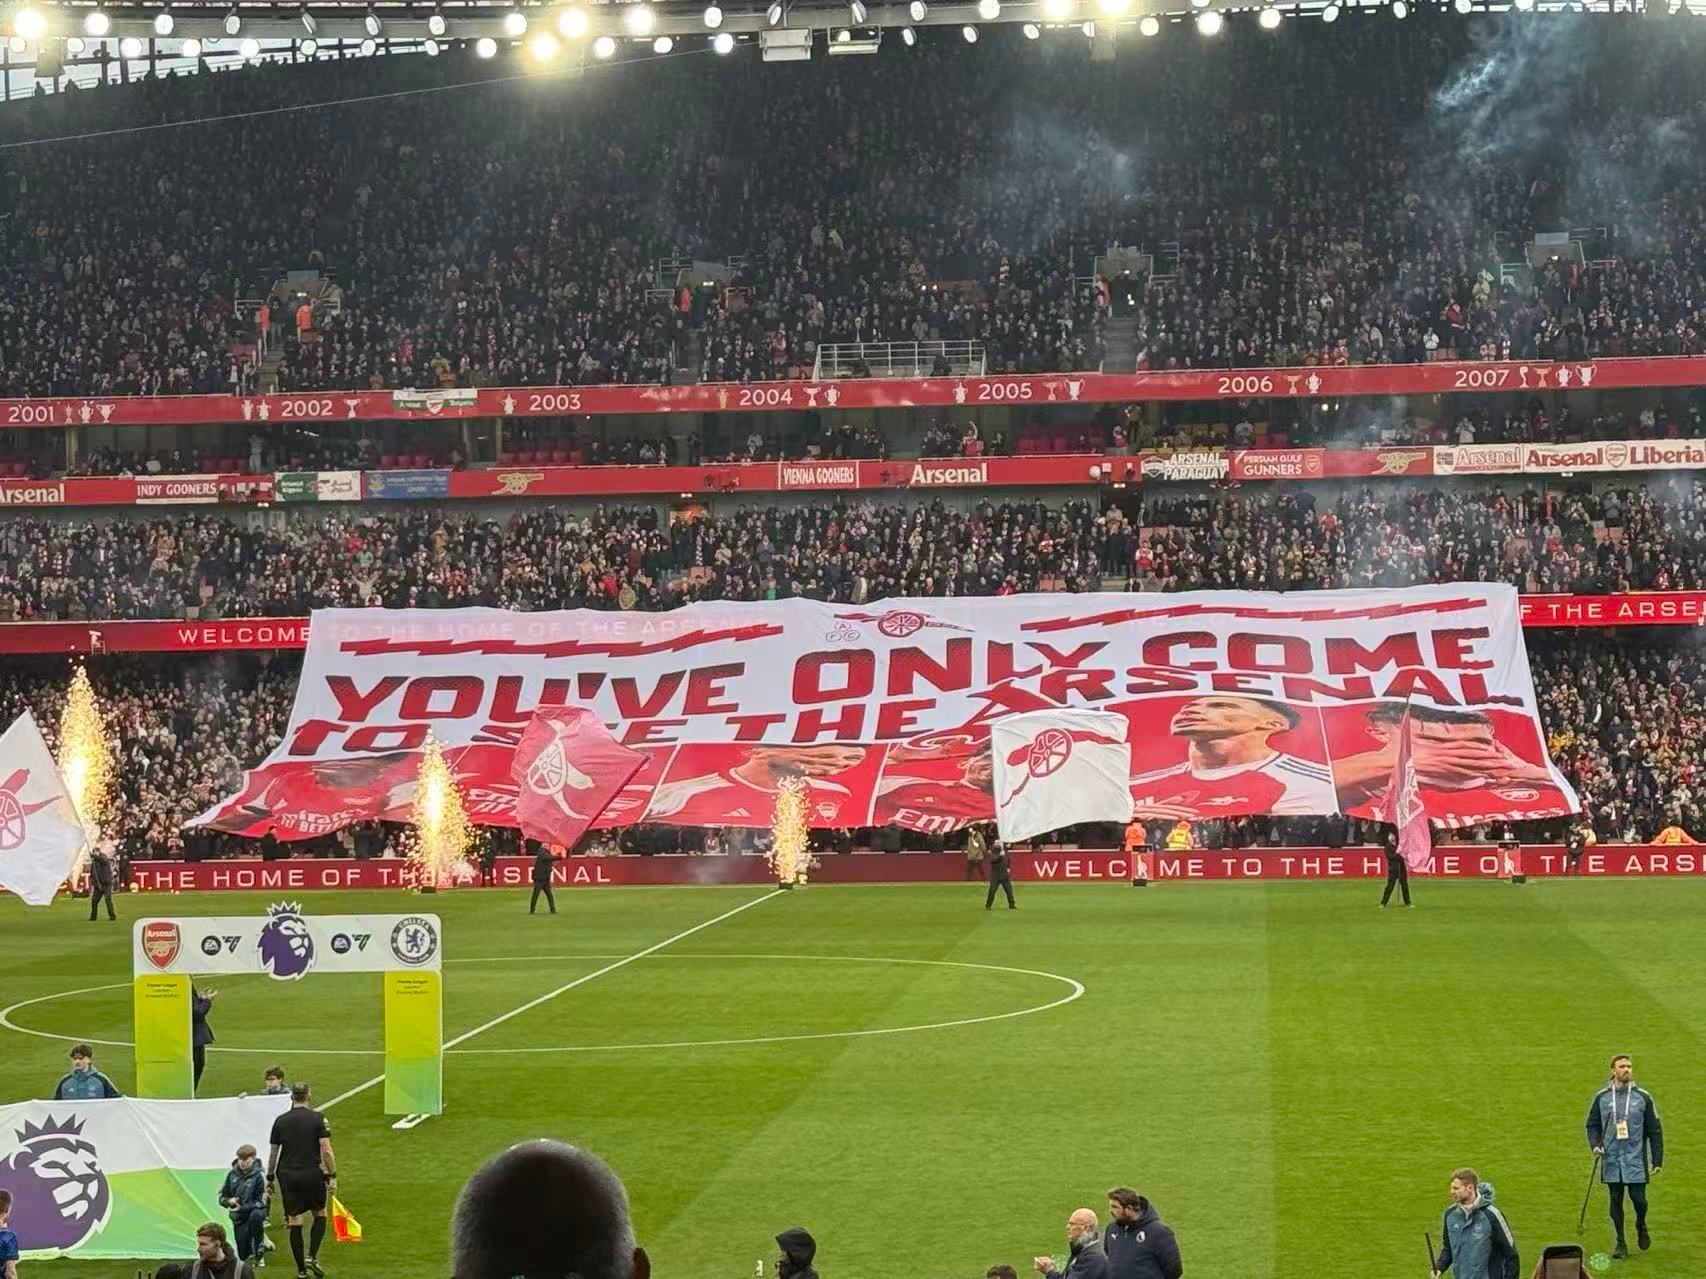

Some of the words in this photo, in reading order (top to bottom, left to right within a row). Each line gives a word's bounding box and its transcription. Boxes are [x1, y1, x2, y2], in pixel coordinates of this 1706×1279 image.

[1218, 376, 1273, 394] 2006
[1455, 369, 1510, 387] 2007
[740, 388, 793, 406] 2004
[979, 382, 1032, 400] 2005
[281, 400, 333, 417] 2002
[529, 394, 582, 411] 2003
[8, 405, 54, 422] 2001
[1170, 453, 1220, 466] ARSENAL
[1243, 455, 1278, 464] PERSIAN
[1280, 454, 1302, 463] GULF
[1459, 447, 1520, 464] Arsenal
[1526, 448, 1603, 467] Arsenal
[1630, 446, 1704, 464] Liberia
[783, 469, 814, 484] VIENNA
[816, 467, 854, 484] GOONERS
[910, 462, 987, 484] Arsenal
[1164, 466, 1227, 480] PARAGUAY
[1243, 464, 1302, 476] GUNNERS
[137, 484, 162, 496] INDY
[166, 483, 217, 495] GOONERS
[1520, 604, 1533, 620] F
[1548, 603, 1602, 619] THE
[1618, 601, 1706, 617] ARSE
[178, 627, 311, 643] WELCOME
[574, 621, 626, 636] THE
[326, 662, 745, 723] YOU'VE
[793, 637, 1111, 705] ONLY
[1142, 627, 1494, 675] COME
[288, 719, 431, 756] TO
[471, 717, 688, 746] SE
[725, 699, 936, 743] THE
[908, 666, 1524, 747] ARSENAL
[1034, 858, 1204, 878] WELCME
[1222, 857, 1263, 876] TO
[1281, 857, 1344, 875] THE
[1363, 856, 1460, 874] HE
[1540, 855, 1606, 873] TE
[1625, 855, 1706, 872] ARS
[135, 871, 196, 889] THE
[213, 869, 304, 887] HOME
[322, 868, 362, 886] OF
[457, 866, 611, 886] ASNAL
